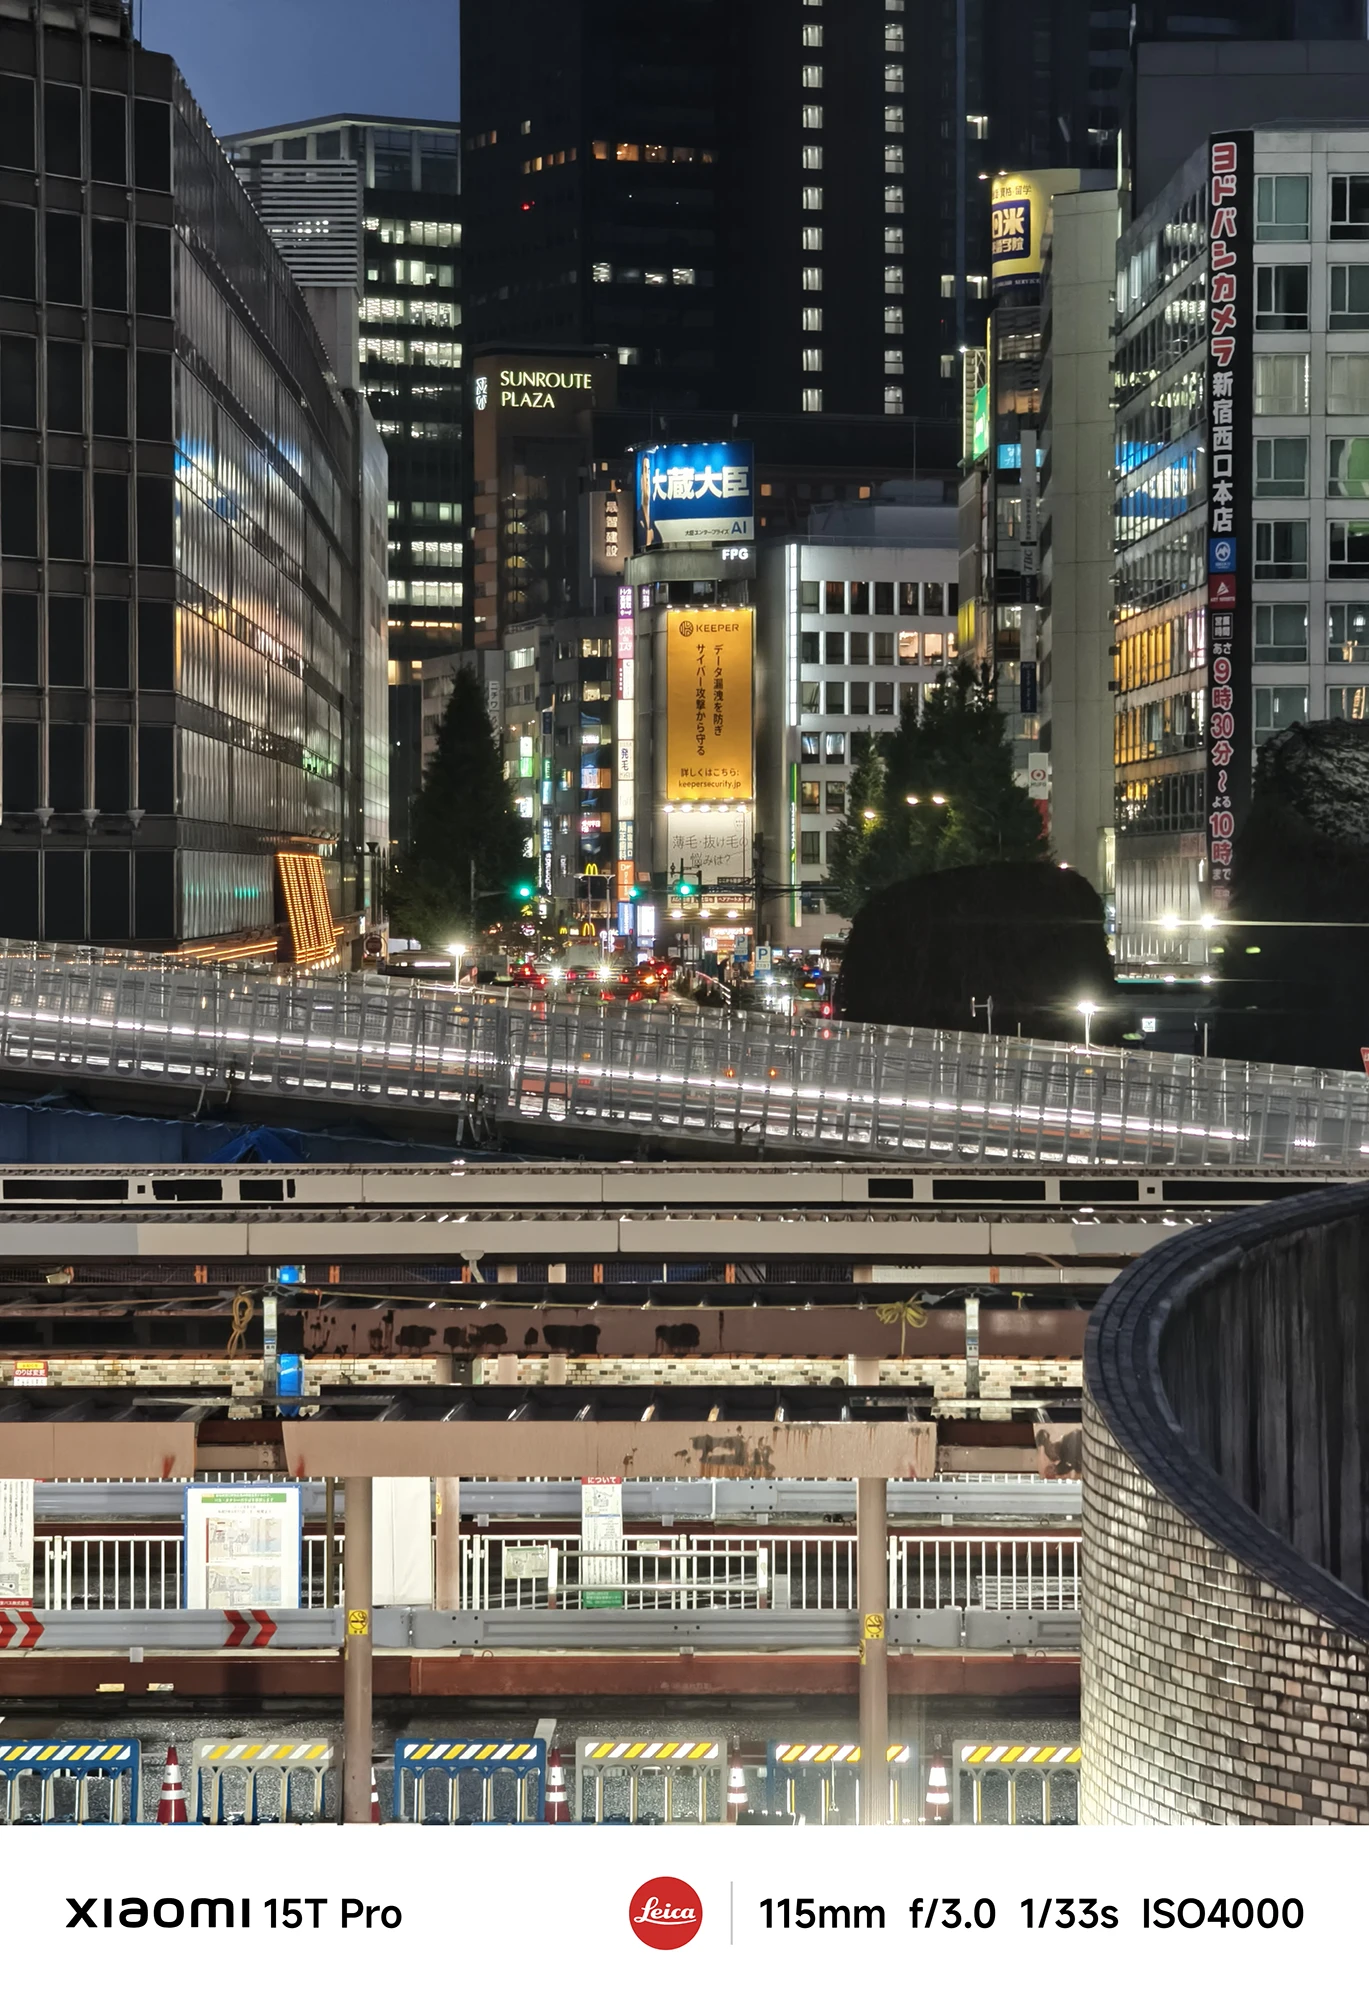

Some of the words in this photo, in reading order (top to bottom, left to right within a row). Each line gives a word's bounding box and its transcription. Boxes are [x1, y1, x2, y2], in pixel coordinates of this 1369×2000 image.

[1211, 142, 1237, 367] ヨドバシカメラ
[500, 370, 592, 390] SUNROUTE
[501, 391, 555, 408] PLAZA
[1212, 372, 1234, 533] 新宿西口本店
[652, 466, 750, 501] 大蔵大臣
[731, 521, 747, 534] AI
[722, 548, 749, 560] FPG
[696, 624, 739, 633] KEEPER
[713, 644, 724, 736] データ漏洩を防ぎ
[696, 643, 706, 756] サイバー攻撃から守る
[678, 780, 742, 789] keepersecurity.jp
[737, 936, 746, 947] P
[758, 948, 768, 960] P
[587, 1476, 617, 1484] について
